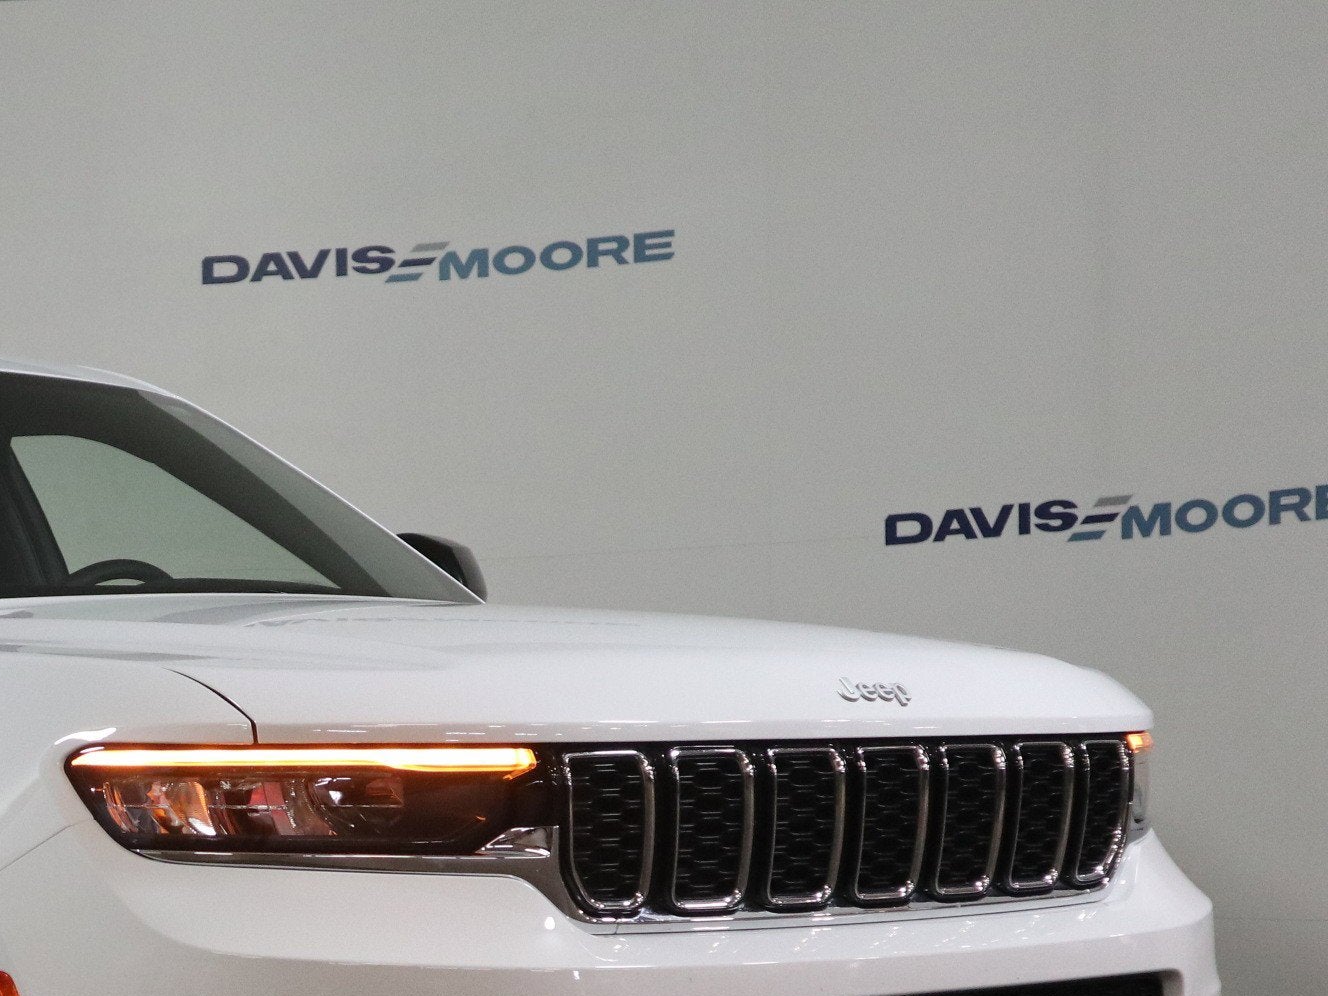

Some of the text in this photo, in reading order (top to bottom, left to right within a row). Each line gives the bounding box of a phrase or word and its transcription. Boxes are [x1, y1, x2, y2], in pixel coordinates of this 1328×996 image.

[201, 229, 676, 285] DAVIS MOORE
[885, 500, 1079, 546] DAVIS
[836, 676, 912, 707] Jeep
